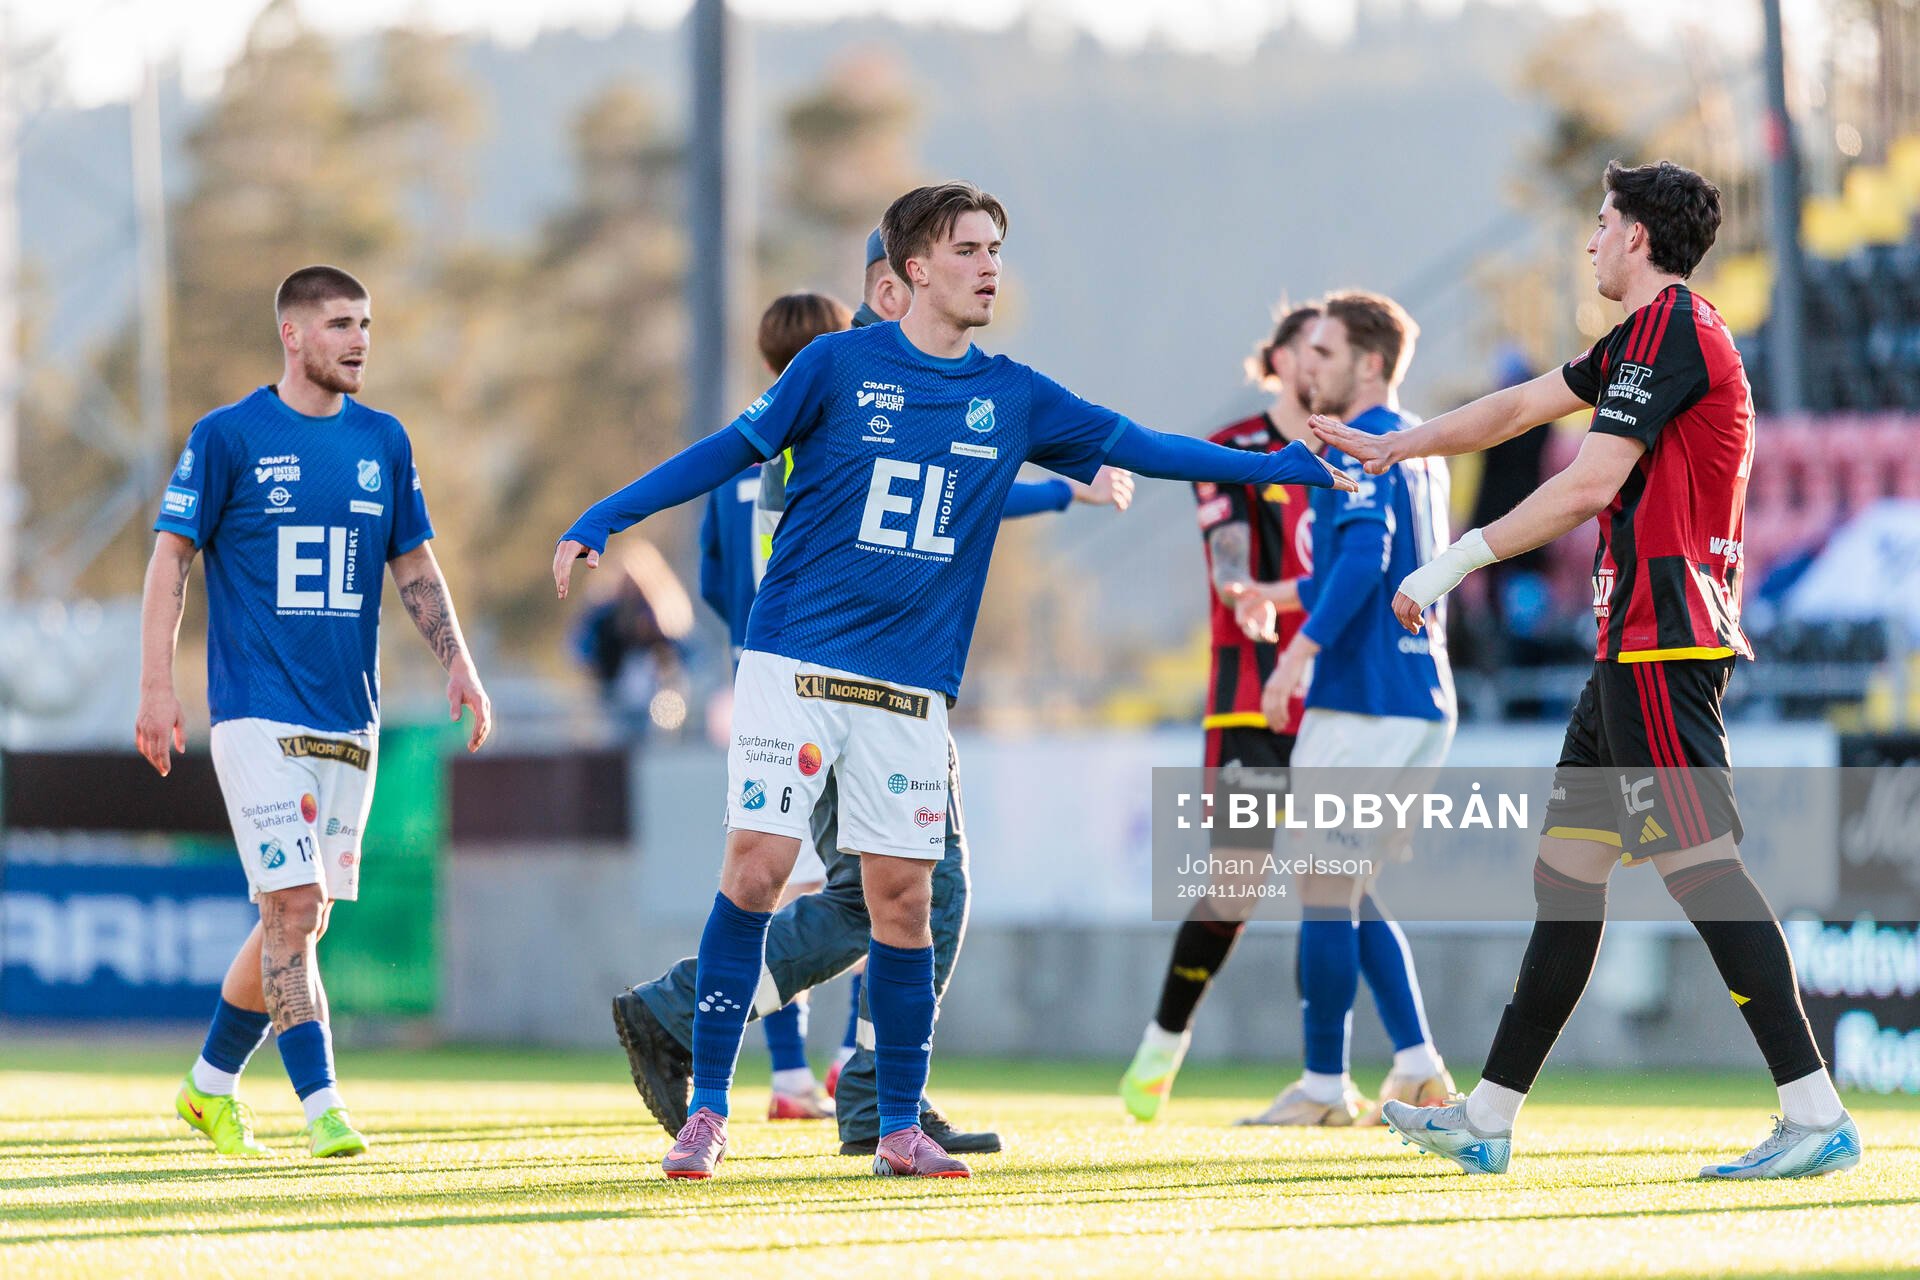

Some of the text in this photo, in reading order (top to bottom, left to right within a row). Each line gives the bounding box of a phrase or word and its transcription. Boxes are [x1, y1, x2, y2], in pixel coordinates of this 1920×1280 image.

[863, 381, 896, 391] CRAFT
[875, 400, 904, 411] SPORT
[876, 392, 904, 404] INTER
[1635, 396, 1647, 404] AB
[1599, 408, 1637, 426] stadium
[259, 456, 290, 465] CRAFT
[273, 466, 300, 474] INTER
[273, 474, 300, 482] SPORT
[858, 457, 958, 555] EL PROJEKT.
[855, 543, 895, 555] KOMPLETTA
[277, 526, 363, 610] EL PROJEKT.
[796, 676, 823, 697] XL
[830, 683, 885, 702] NORRBY
[888, 695, 912, 711] TRÄ
[280, 738, 308, 756] XL
[738, 735, 795, 751] Sparbanken
[745, 749, 793, 766] Sjuhärad
[910, 780, 941, 790] Brink
[780, 786, 793, 813] 6
[253, 812, 298, 831] Sjuhärad
